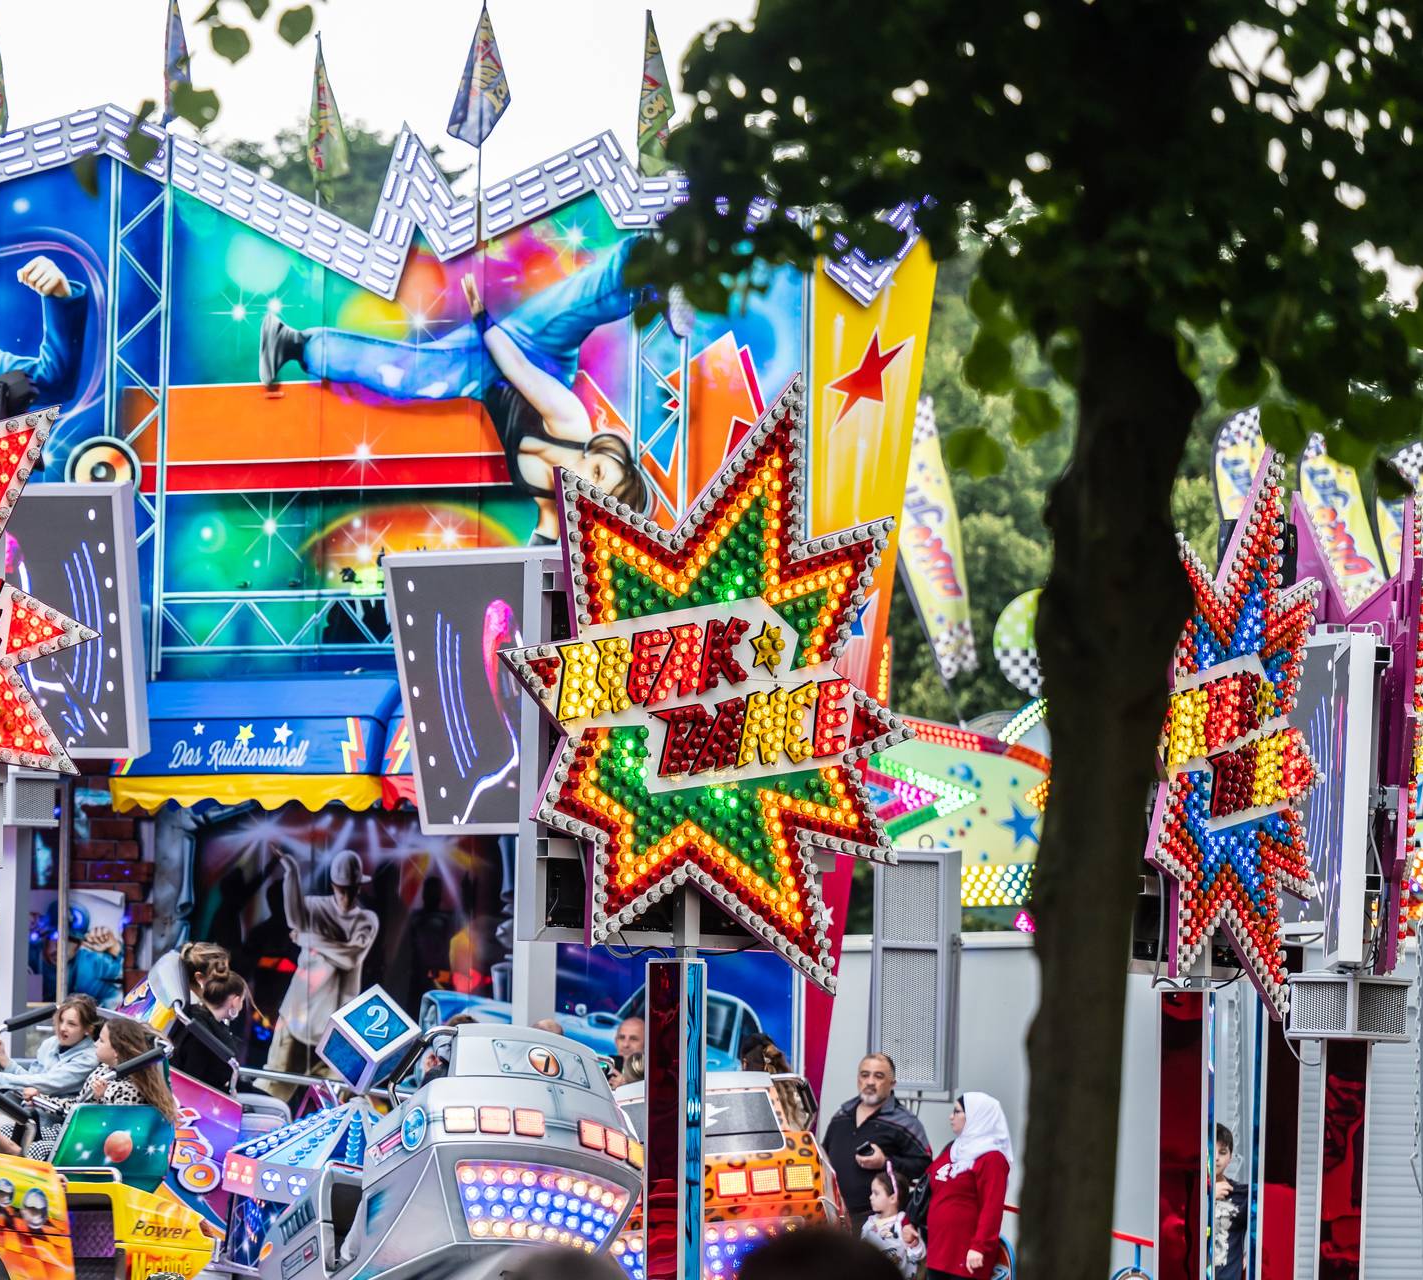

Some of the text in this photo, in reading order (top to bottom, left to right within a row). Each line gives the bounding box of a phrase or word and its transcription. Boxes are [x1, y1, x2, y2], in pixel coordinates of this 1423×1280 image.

[556, 616, 751, 722] BREAK
[647, 678, 851, 777] DANCE
[168, 739, 310, 771] Das Kultkarussell
[364, 1005, 390, 1039] 2
[535, 1053, 551, 1074] 7
[132, 1219, 191, 1241] Power
